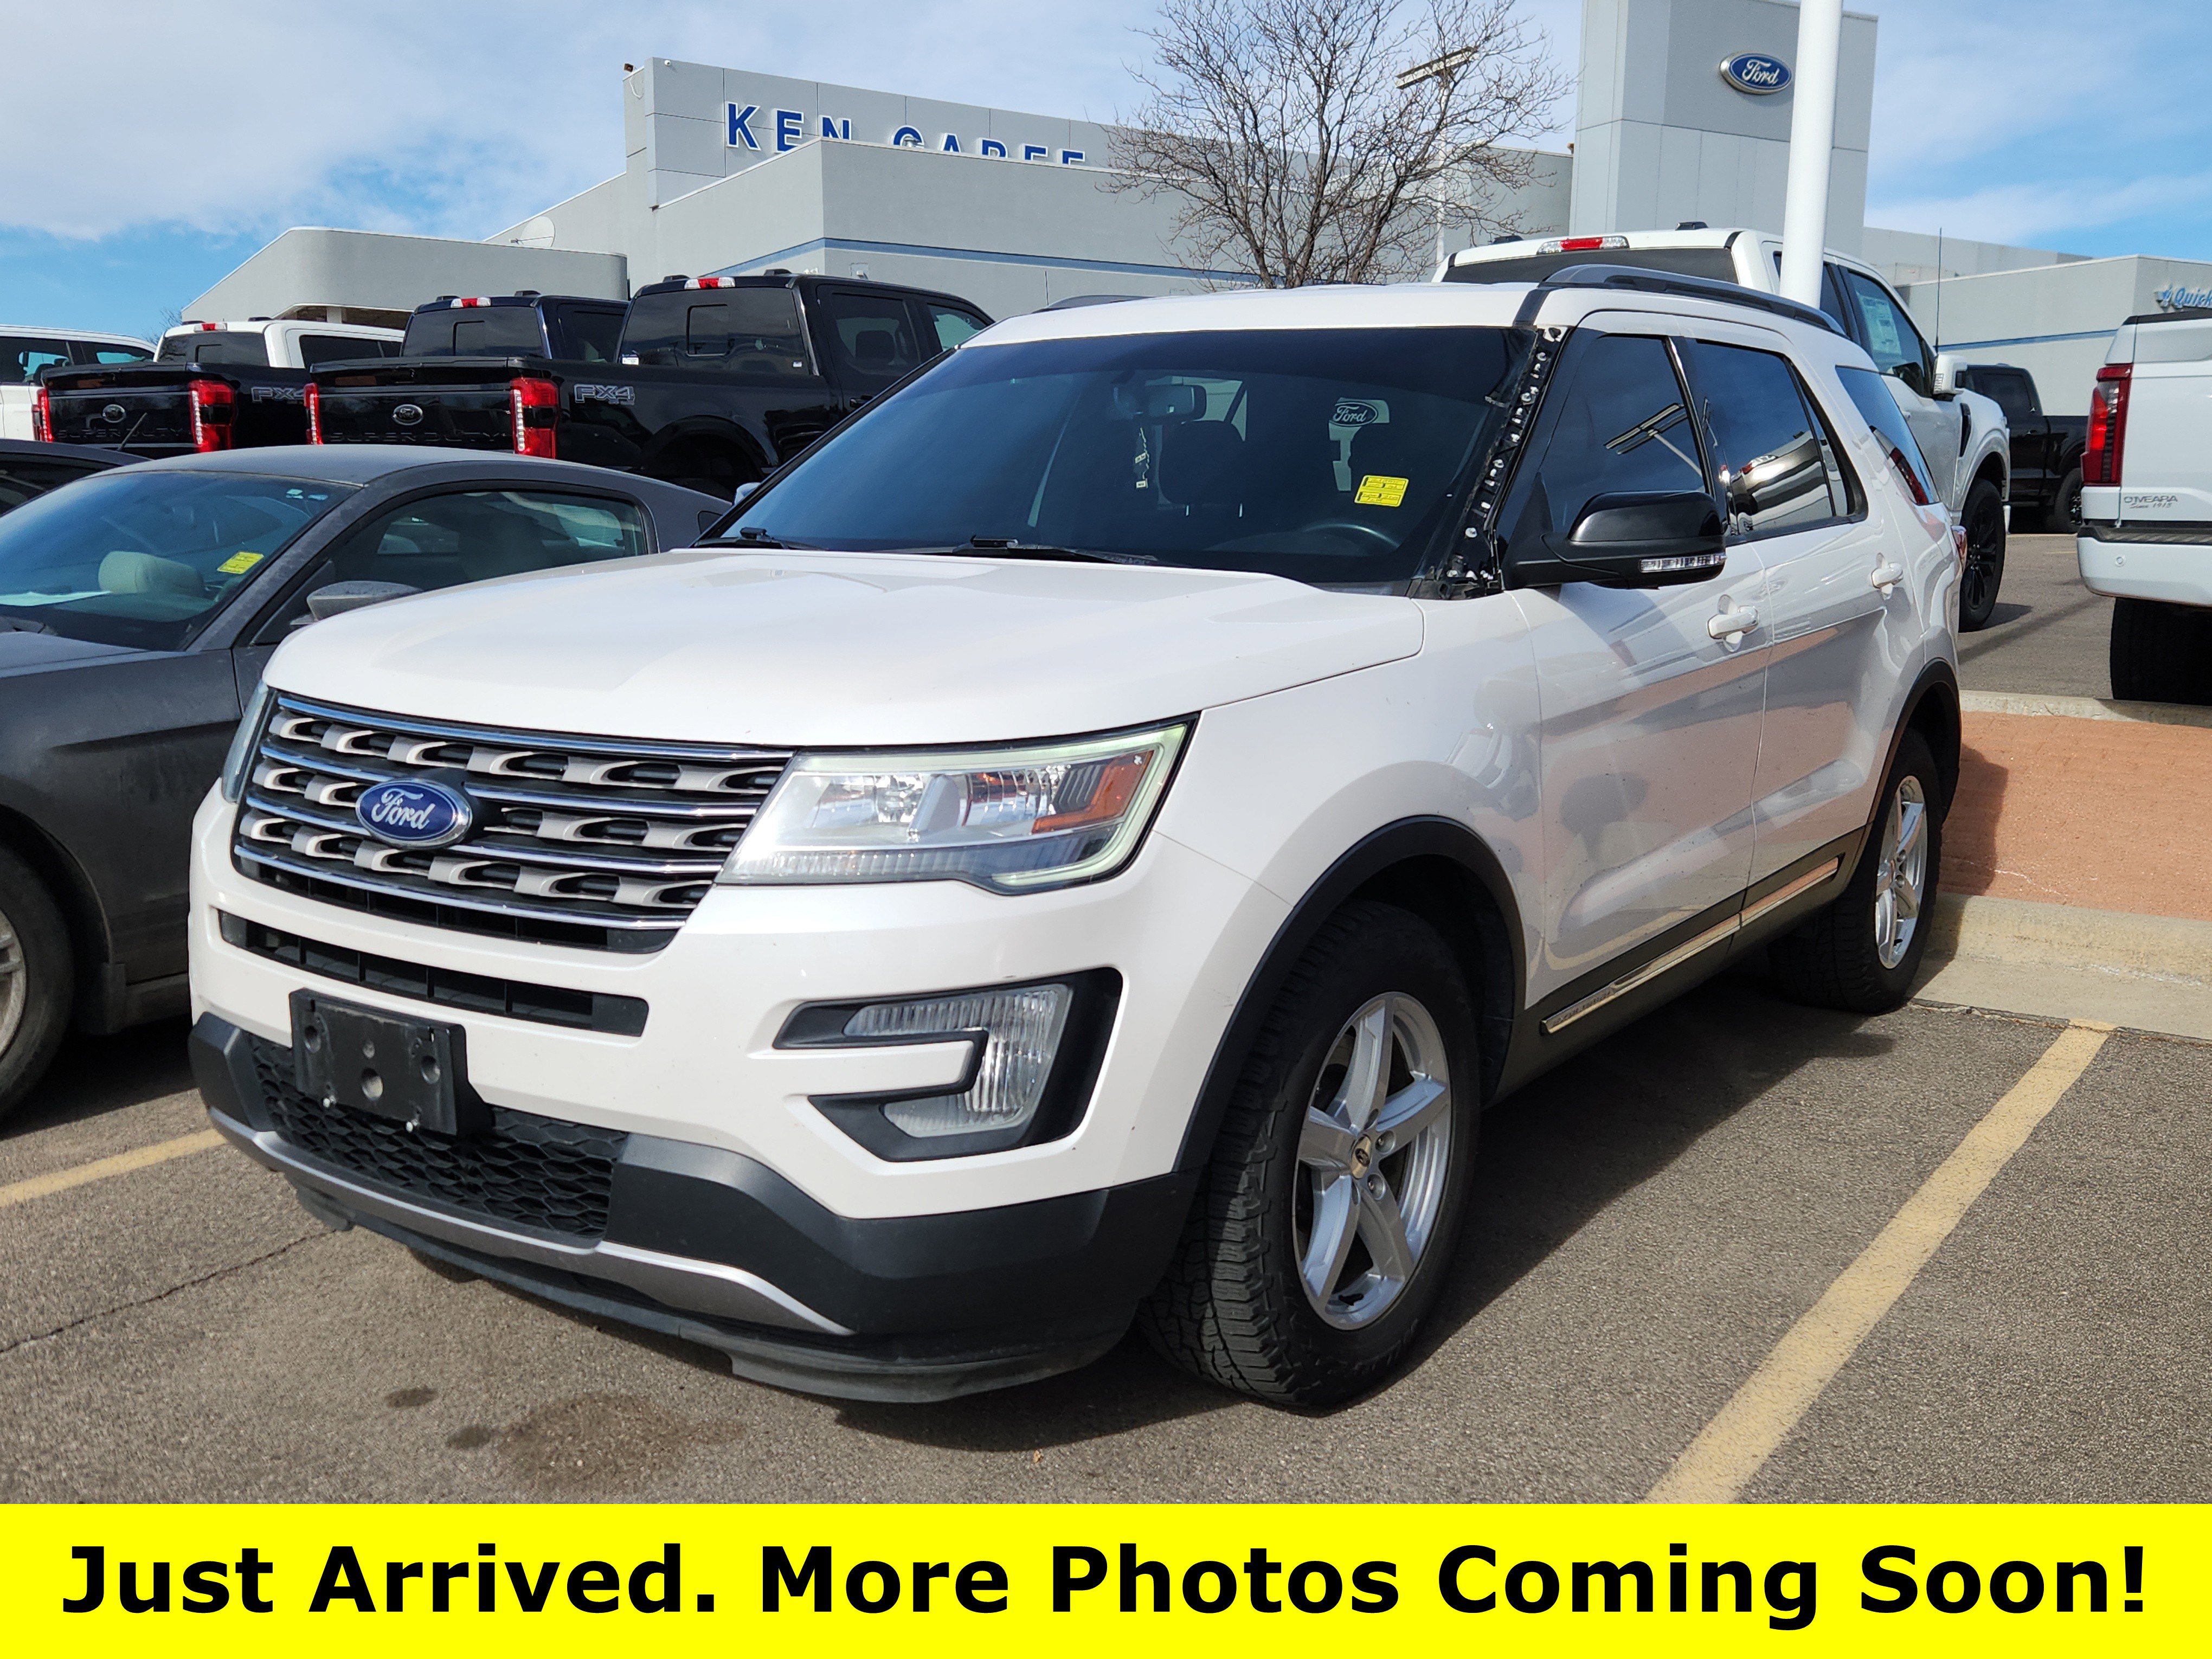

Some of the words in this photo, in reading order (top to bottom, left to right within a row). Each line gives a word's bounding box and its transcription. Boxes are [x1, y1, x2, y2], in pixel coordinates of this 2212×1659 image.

[1741, 58, 1780, 85] Ford
[726, 101, 852, 153] KEN
[574, 383, 635, 406] FX4
[1332, 406, 1368, 422] Ford
[371, 788, 436, 830] Ford
